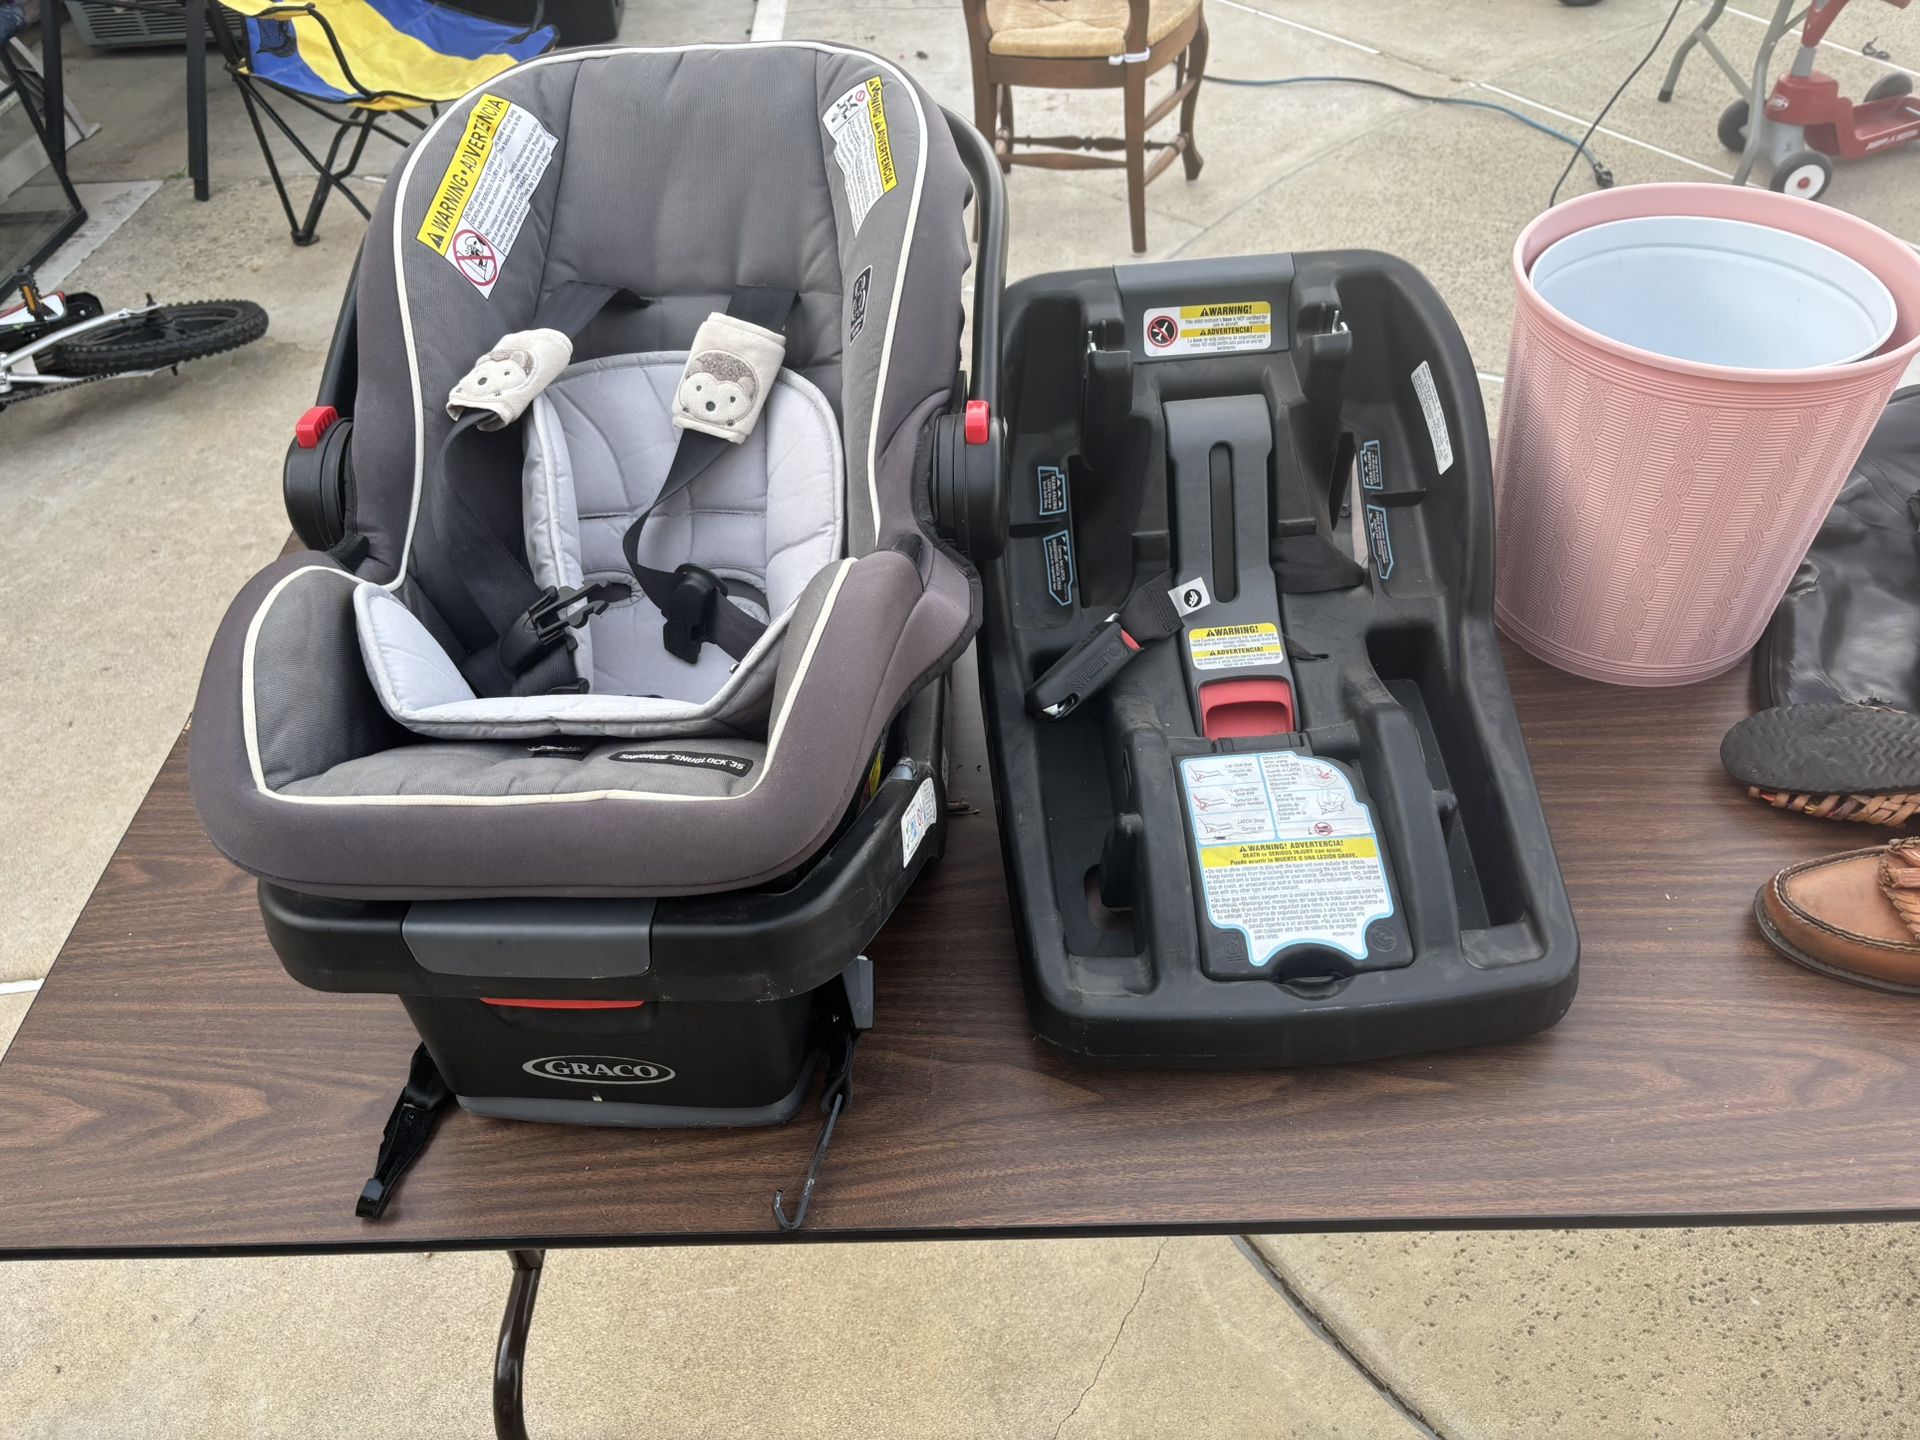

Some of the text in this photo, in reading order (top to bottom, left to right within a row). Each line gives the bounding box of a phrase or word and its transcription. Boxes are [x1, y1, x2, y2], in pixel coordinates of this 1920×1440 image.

[877, 128, 893, 185] ADVERTENCIA
[431, 173, 469, 232] WARNING
[1209, 304, 1252, 316] WARNING!
[1207, 325, 1252, 335] ADVERTENCIA!
[1213, 625, 1258, 636] WARNING!
[1216, 646, 1263, 655] ADVERTENCIA!
[673, 754, 728, 766] SNUGLOCK
[730, 761, 746, 770] 35
[1247, 838, 1344, 851] WARNING! ADVERTENCIA!
[544, 1060, 659, 1078] GRACO
